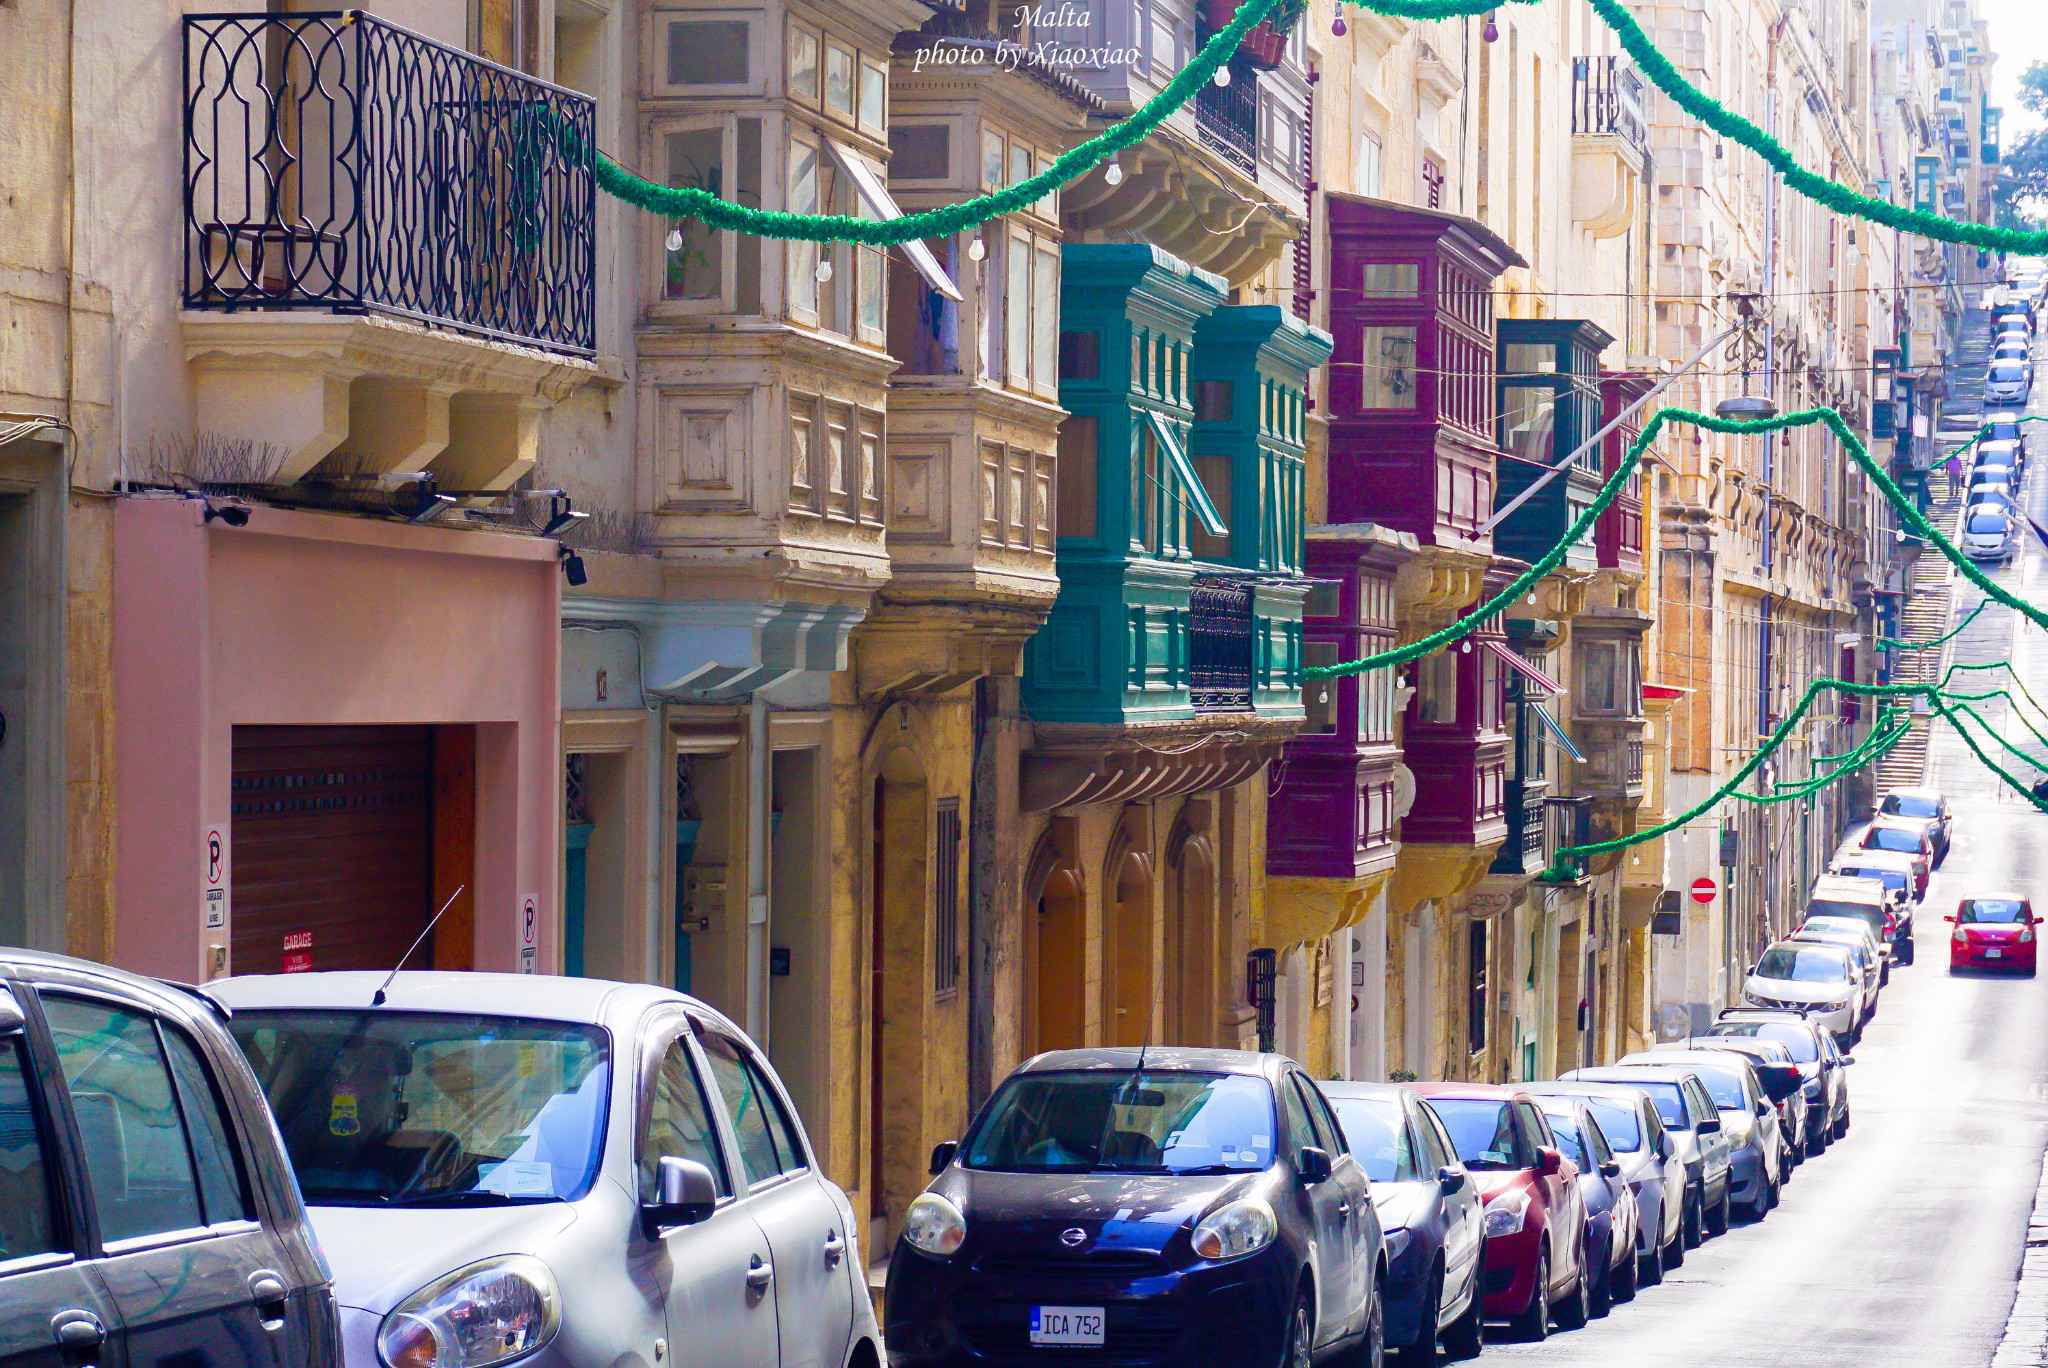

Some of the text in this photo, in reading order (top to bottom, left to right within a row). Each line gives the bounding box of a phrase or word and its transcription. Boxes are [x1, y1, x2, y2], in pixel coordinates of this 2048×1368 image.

[283, 932, 312, 950] GARAGE
[1043, 1314, 1101, 1335] ICA 752
